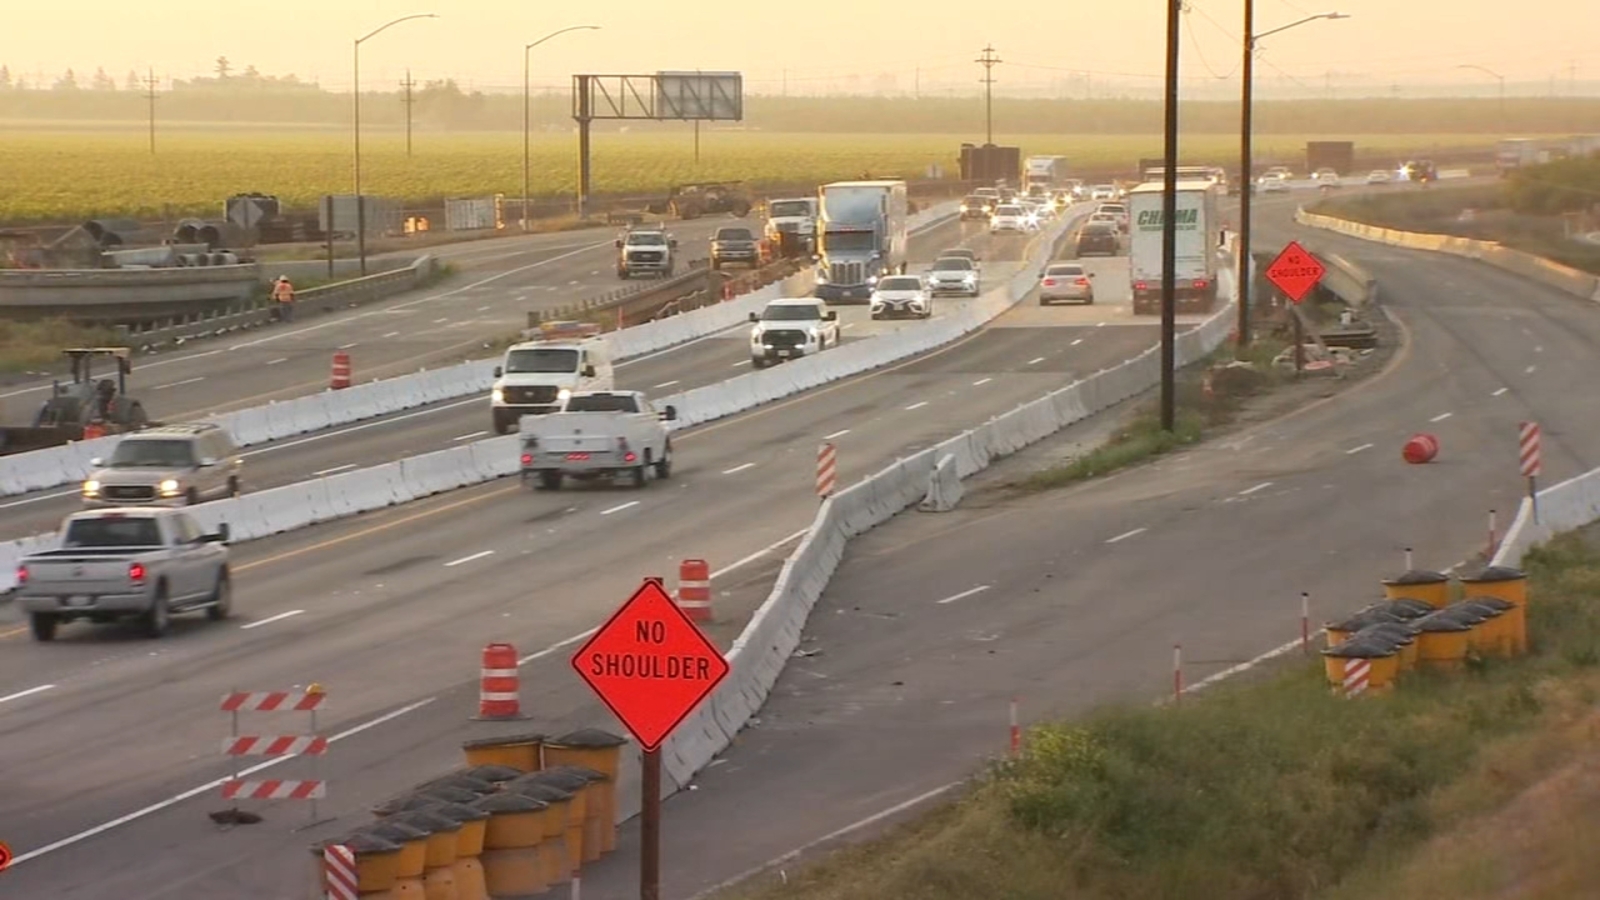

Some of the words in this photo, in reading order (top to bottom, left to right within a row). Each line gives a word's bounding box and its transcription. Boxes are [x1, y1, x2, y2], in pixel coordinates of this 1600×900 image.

[1137, 209, 1198, 225] CHMA
[1288, 255, 1300, 265] NO
[1271, 266, 1319, 278] SHOULDER
[636, 620, 665, 644] NO
[591, 653, 710, 680] SHOULDER
